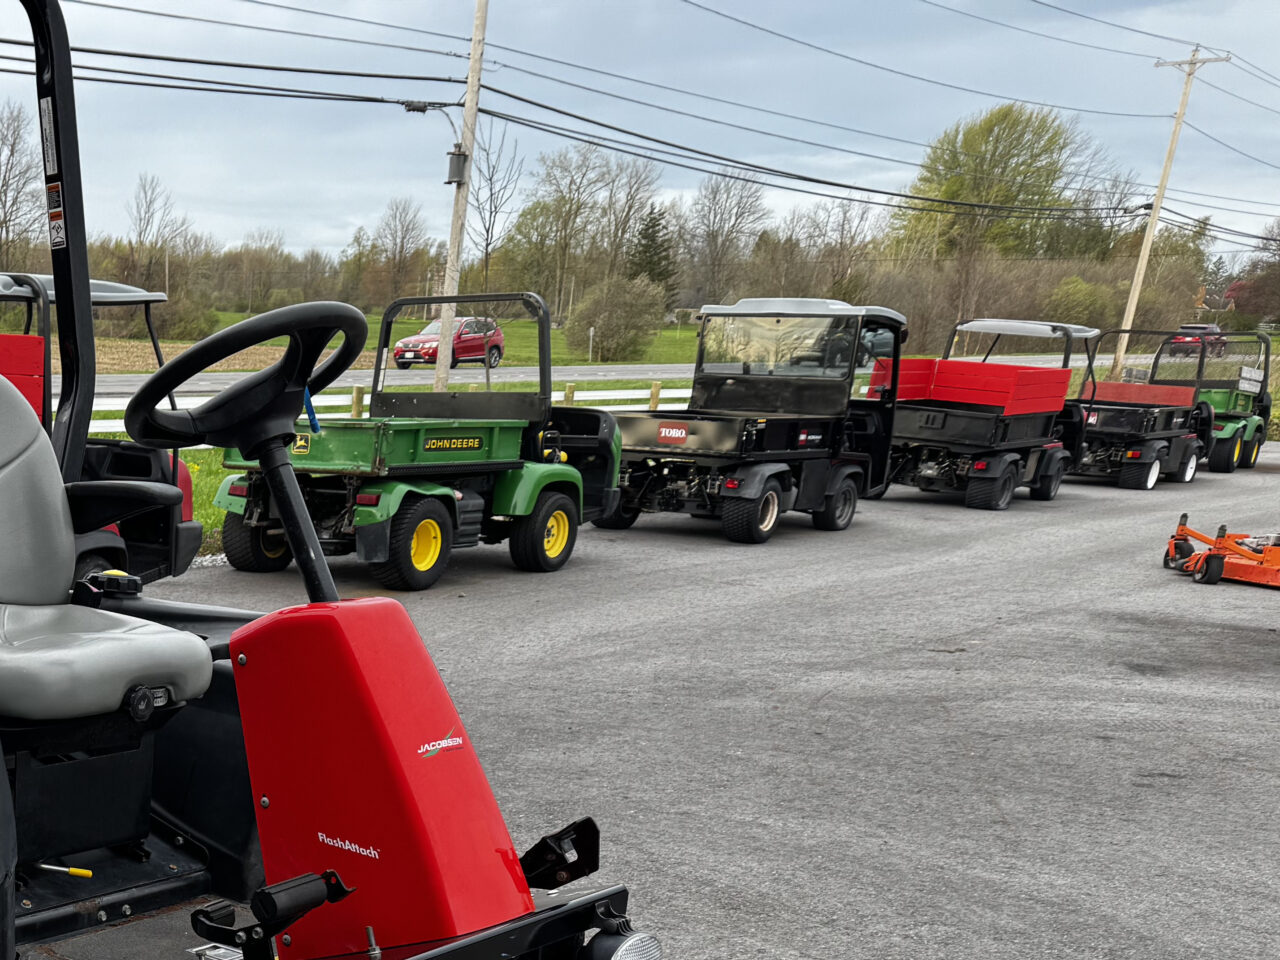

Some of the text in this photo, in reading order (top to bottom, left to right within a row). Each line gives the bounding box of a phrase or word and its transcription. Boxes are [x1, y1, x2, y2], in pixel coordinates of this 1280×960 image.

[660, 427, 686, 438] TORO
[424, 438, 480, 449] JOHN DEERE
[417, 736, 463, 754] JACOBSEN
[317, 831, 380, 860] FlashAttach
